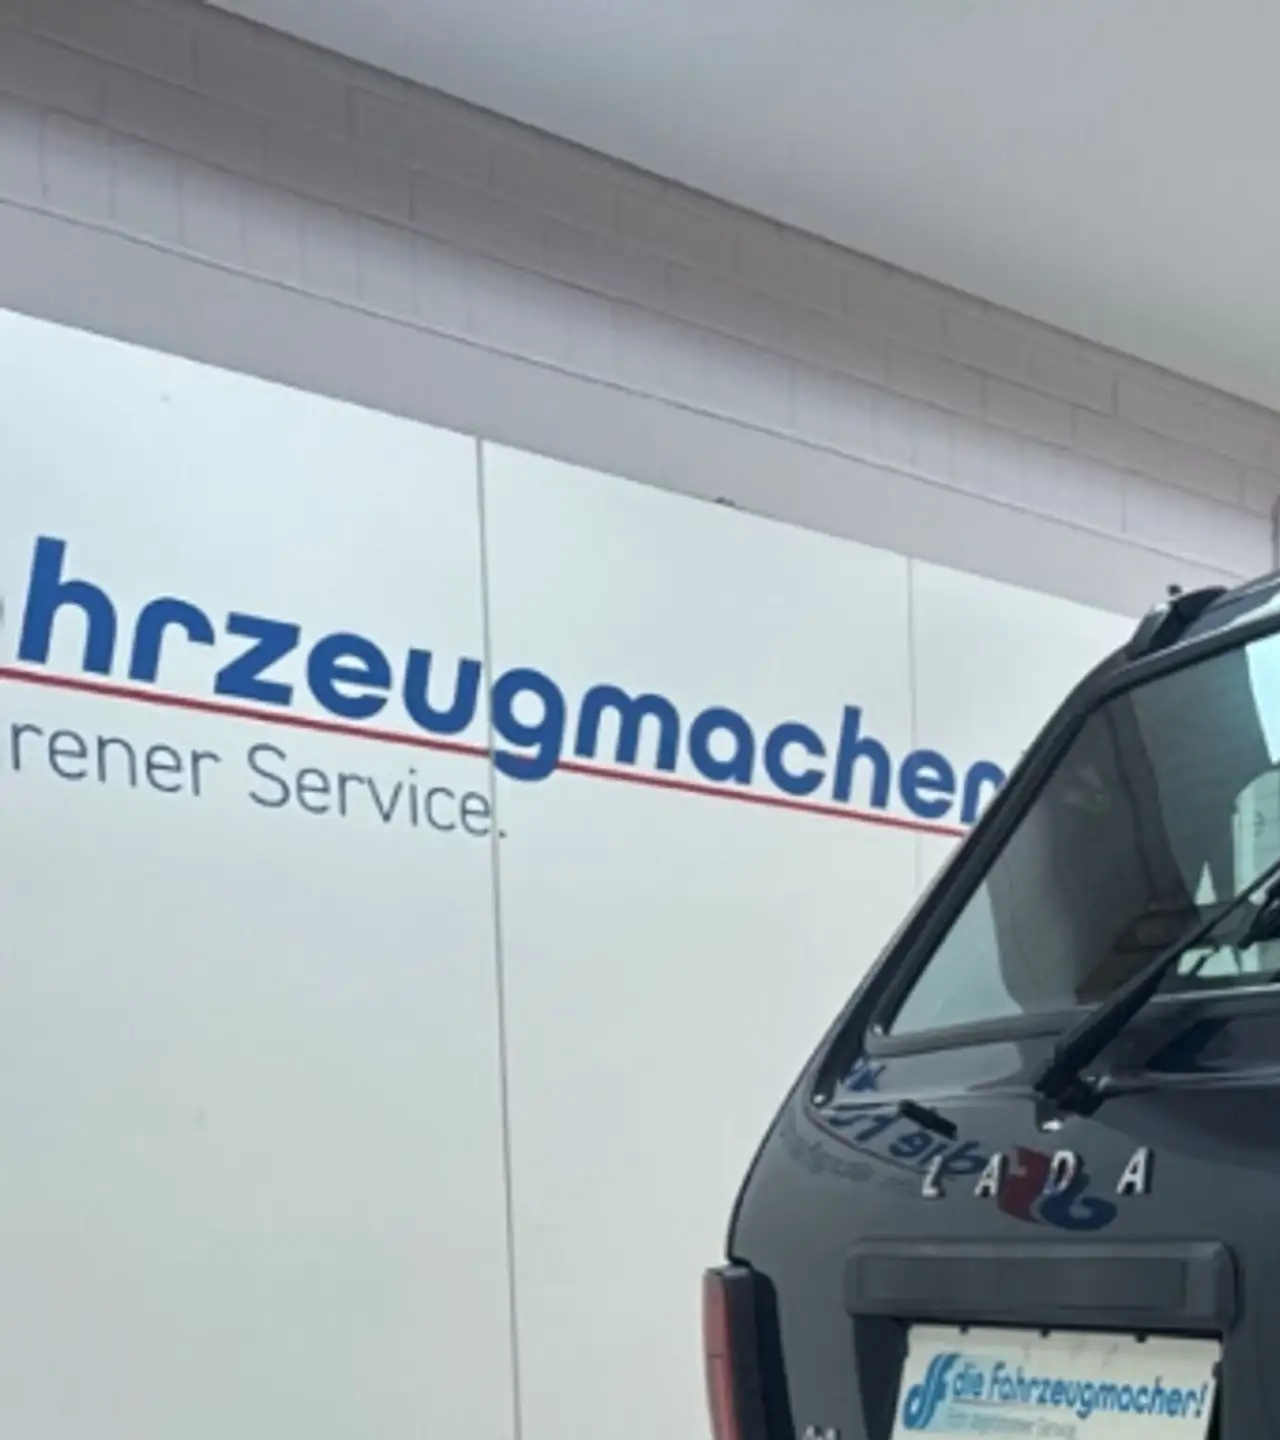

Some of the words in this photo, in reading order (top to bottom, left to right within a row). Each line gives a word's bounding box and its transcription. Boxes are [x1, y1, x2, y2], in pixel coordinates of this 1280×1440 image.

[0, 535, 1008, 825] hrzeugmacher
[10, 722, 222, 797] rener
[247, 741, 509, 839] Service.
[922, 1147, 1149, 1197] LADA
[988, 1361, 1207, 1419] Fahrzeugmacher!
